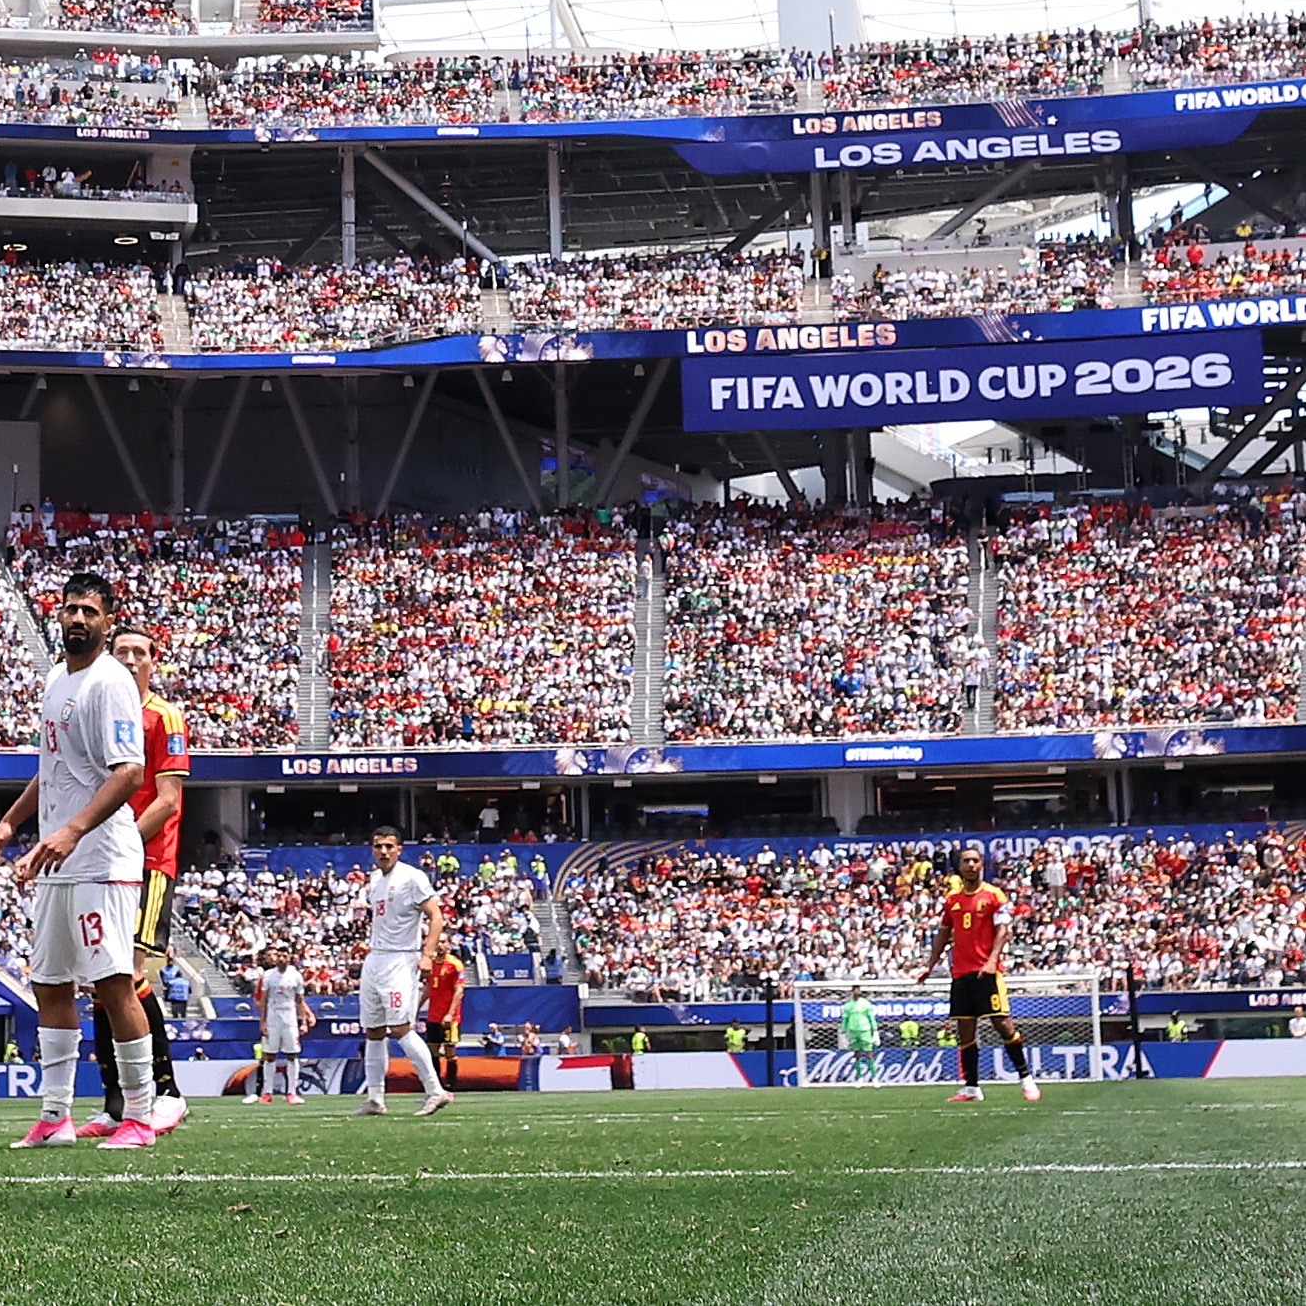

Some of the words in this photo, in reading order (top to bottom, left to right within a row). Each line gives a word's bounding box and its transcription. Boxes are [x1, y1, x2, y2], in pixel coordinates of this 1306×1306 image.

[1175, 89, 1222, 112] FIFA
[1224, 84, 1295, 108] WORLD
[76, 127, 99, 138] LOS
[100, 128, 150, 140] ANGELES
[793, 112, 837, 136] LOS
[841, 110, 942, 133] ANGELES
[814, 143, 904, 169] LOS
[913, 129, 1122, 163] ANGELES
[1142, 305, 1207, 332] FIFA
[685, 330, 749, 355] LOS
[754, 323, 897, 352] ANGELES
[710, 375, 805, 410] FIFA
[808, 368, 971, 408] WORLD
[978, 364, 1067, 399] CUP
[1074, 351, 1235, 395] 2026
[281, 758, 322, 775] LOS
[325, 757, 419, 775] ANGELES
[78, 912, 103, 947] 13
[389, 991, 403, 1009] 18
[905, 1002, 933, 1015] CUP
[1248, 993, 1279, 1006] LOS
